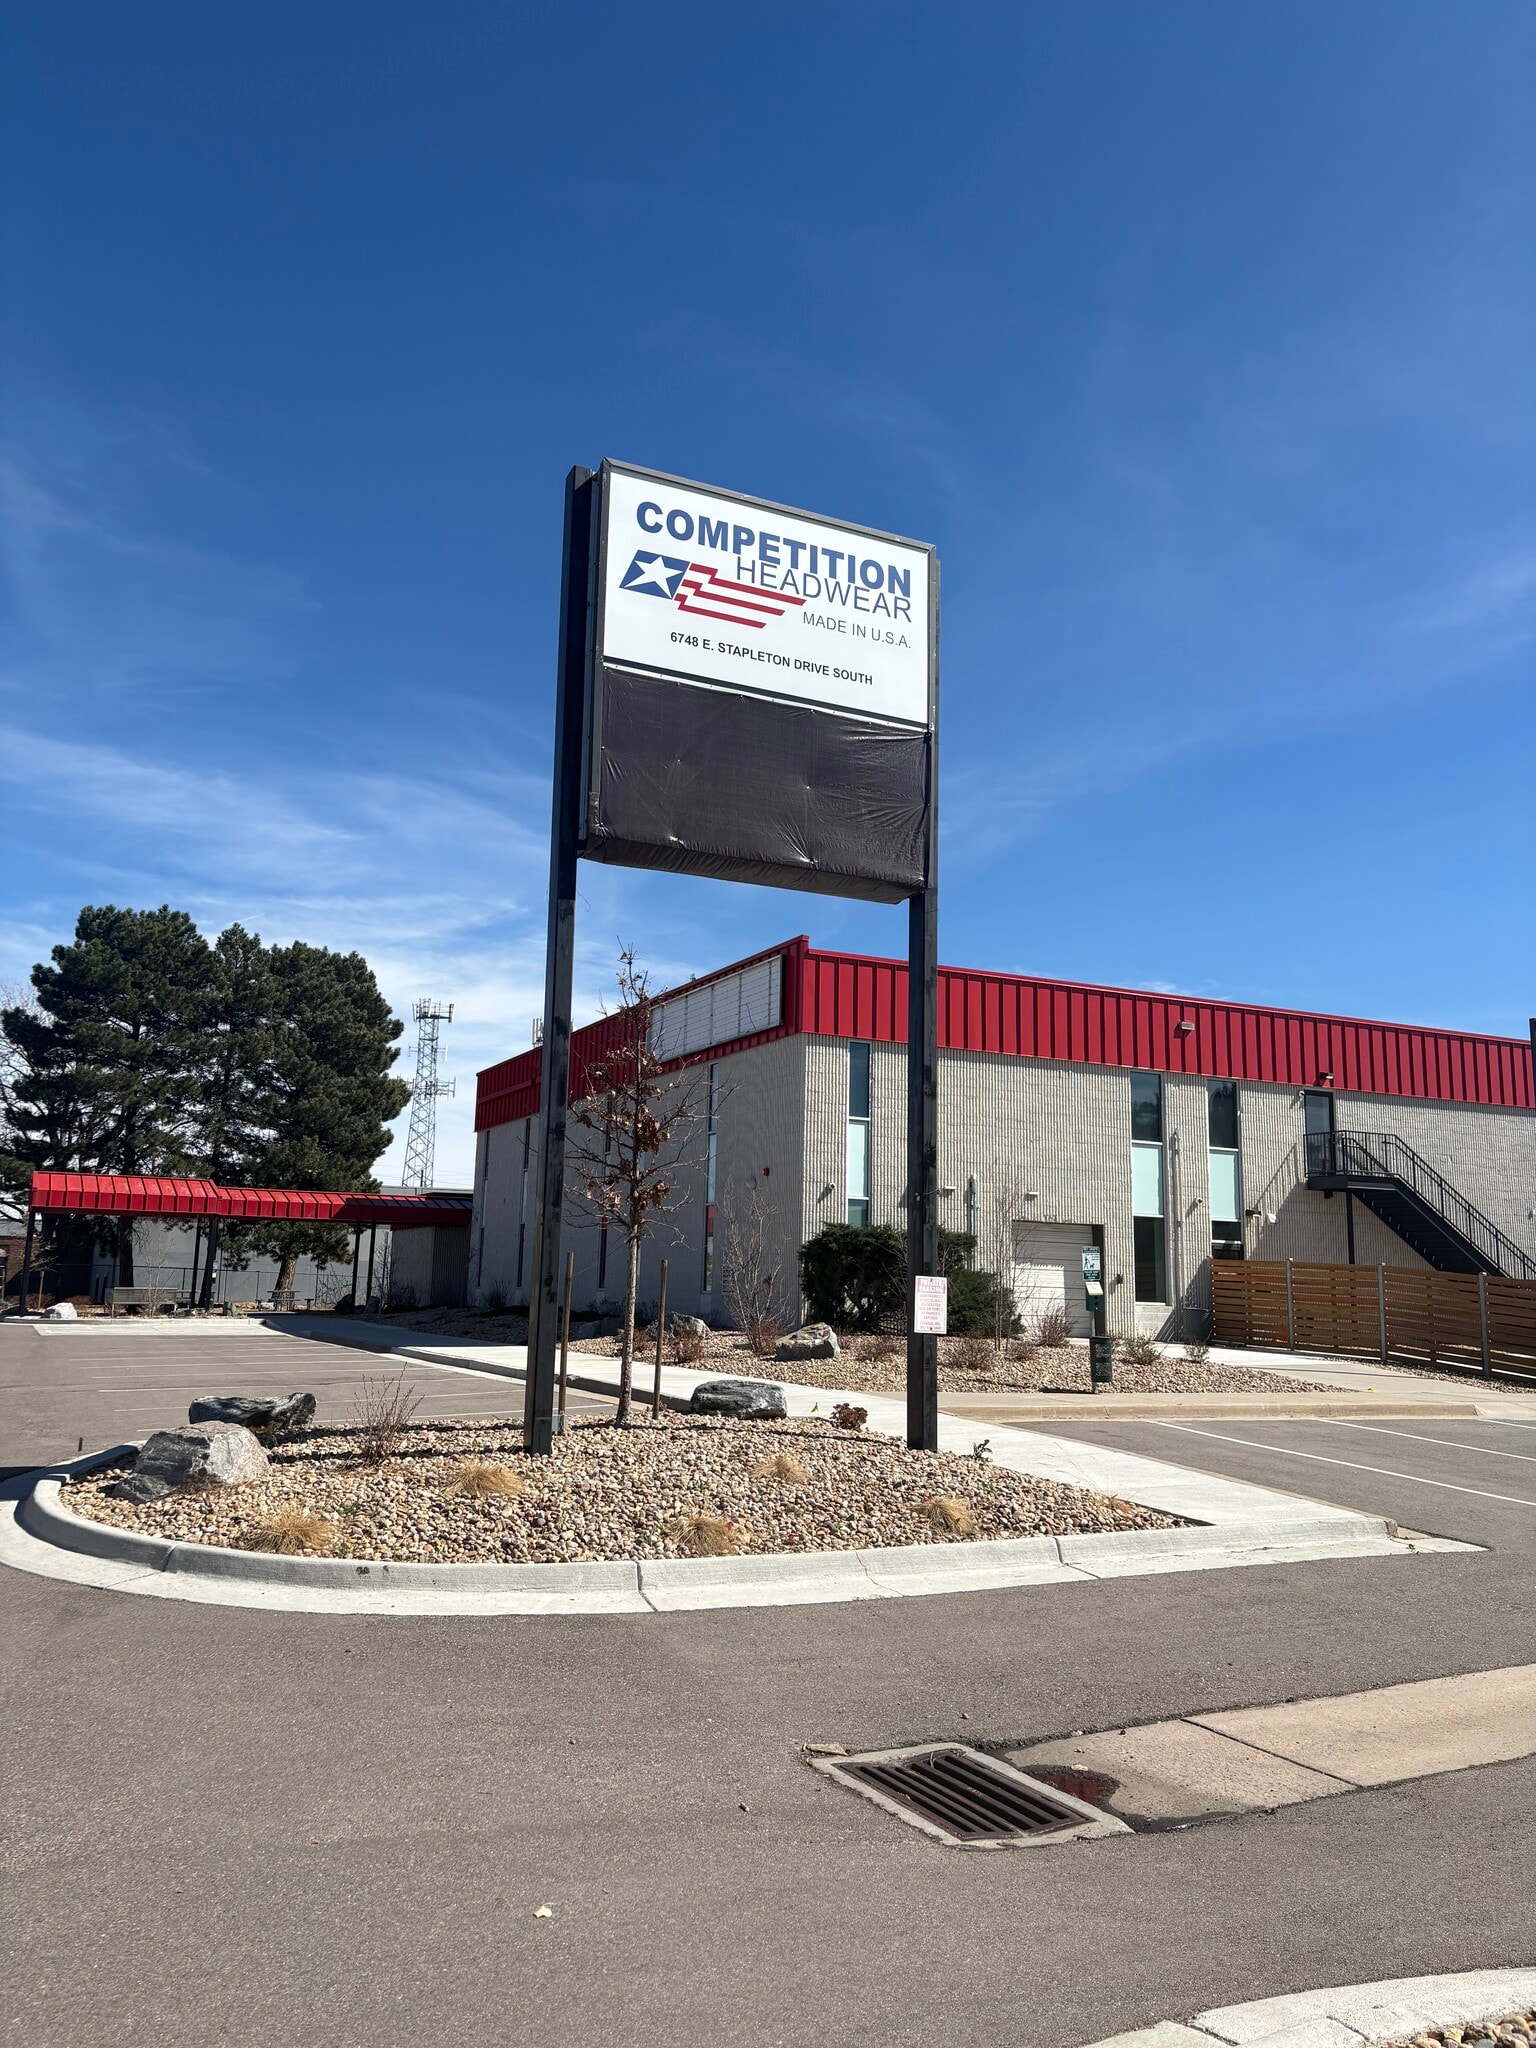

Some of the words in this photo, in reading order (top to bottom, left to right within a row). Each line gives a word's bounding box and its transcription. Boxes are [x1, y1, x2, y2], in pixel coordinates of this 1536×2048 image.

[637, 501, 911, 598] COMPETITION
[736, 555, 912, 623] HEADWEAR
[670, 631, 699, 648] 6748
[702, 639, 715, 651] E.
[718, 642, 791, 668] STAPLETON
[794, 659, 830, 676] DRIVE
[833, 667, 873, 686] SOUTH
[803, 611, 847, 634] MADE
[852, 623, 866, 639] IN
[872, 627, 912, 649] U.S.A.
